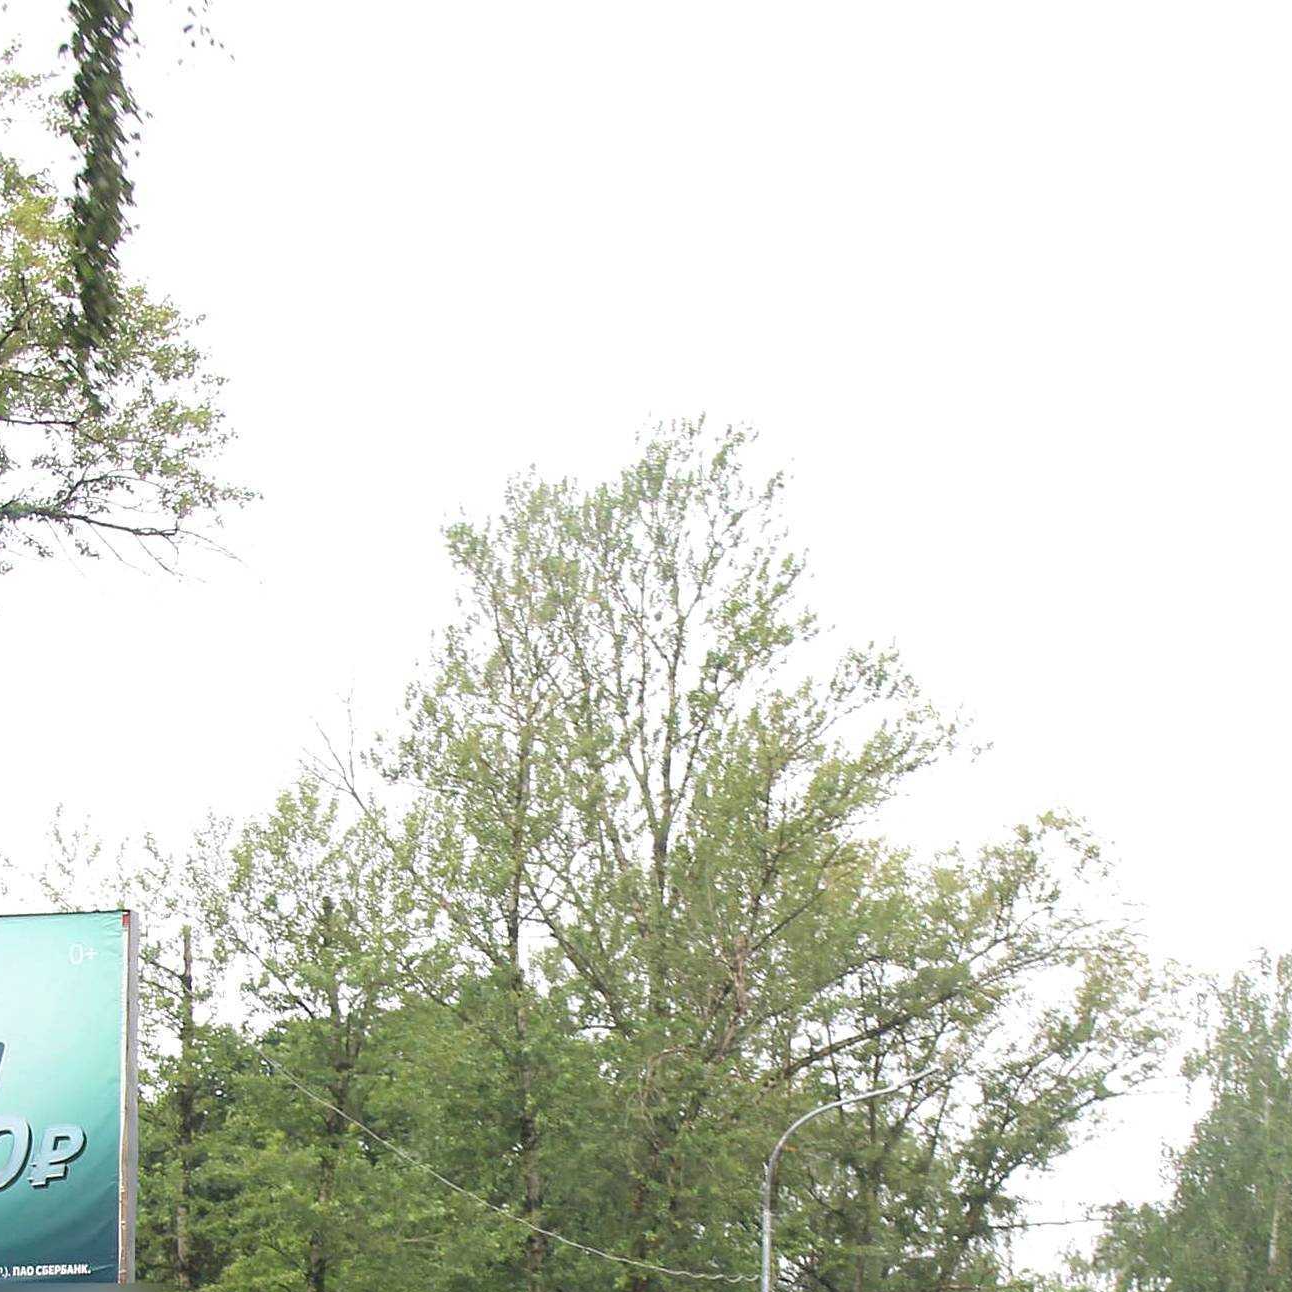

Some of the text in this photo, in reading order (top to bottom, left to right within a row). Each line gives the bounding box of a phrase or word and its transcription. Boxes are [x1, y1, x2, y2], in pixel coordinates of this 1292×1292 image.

[68, 943, 98, 965] 0+
[13, 1265, 34, 1277] ПАО
[35, 1263, 92, 1276] СБЕРБАНК.
